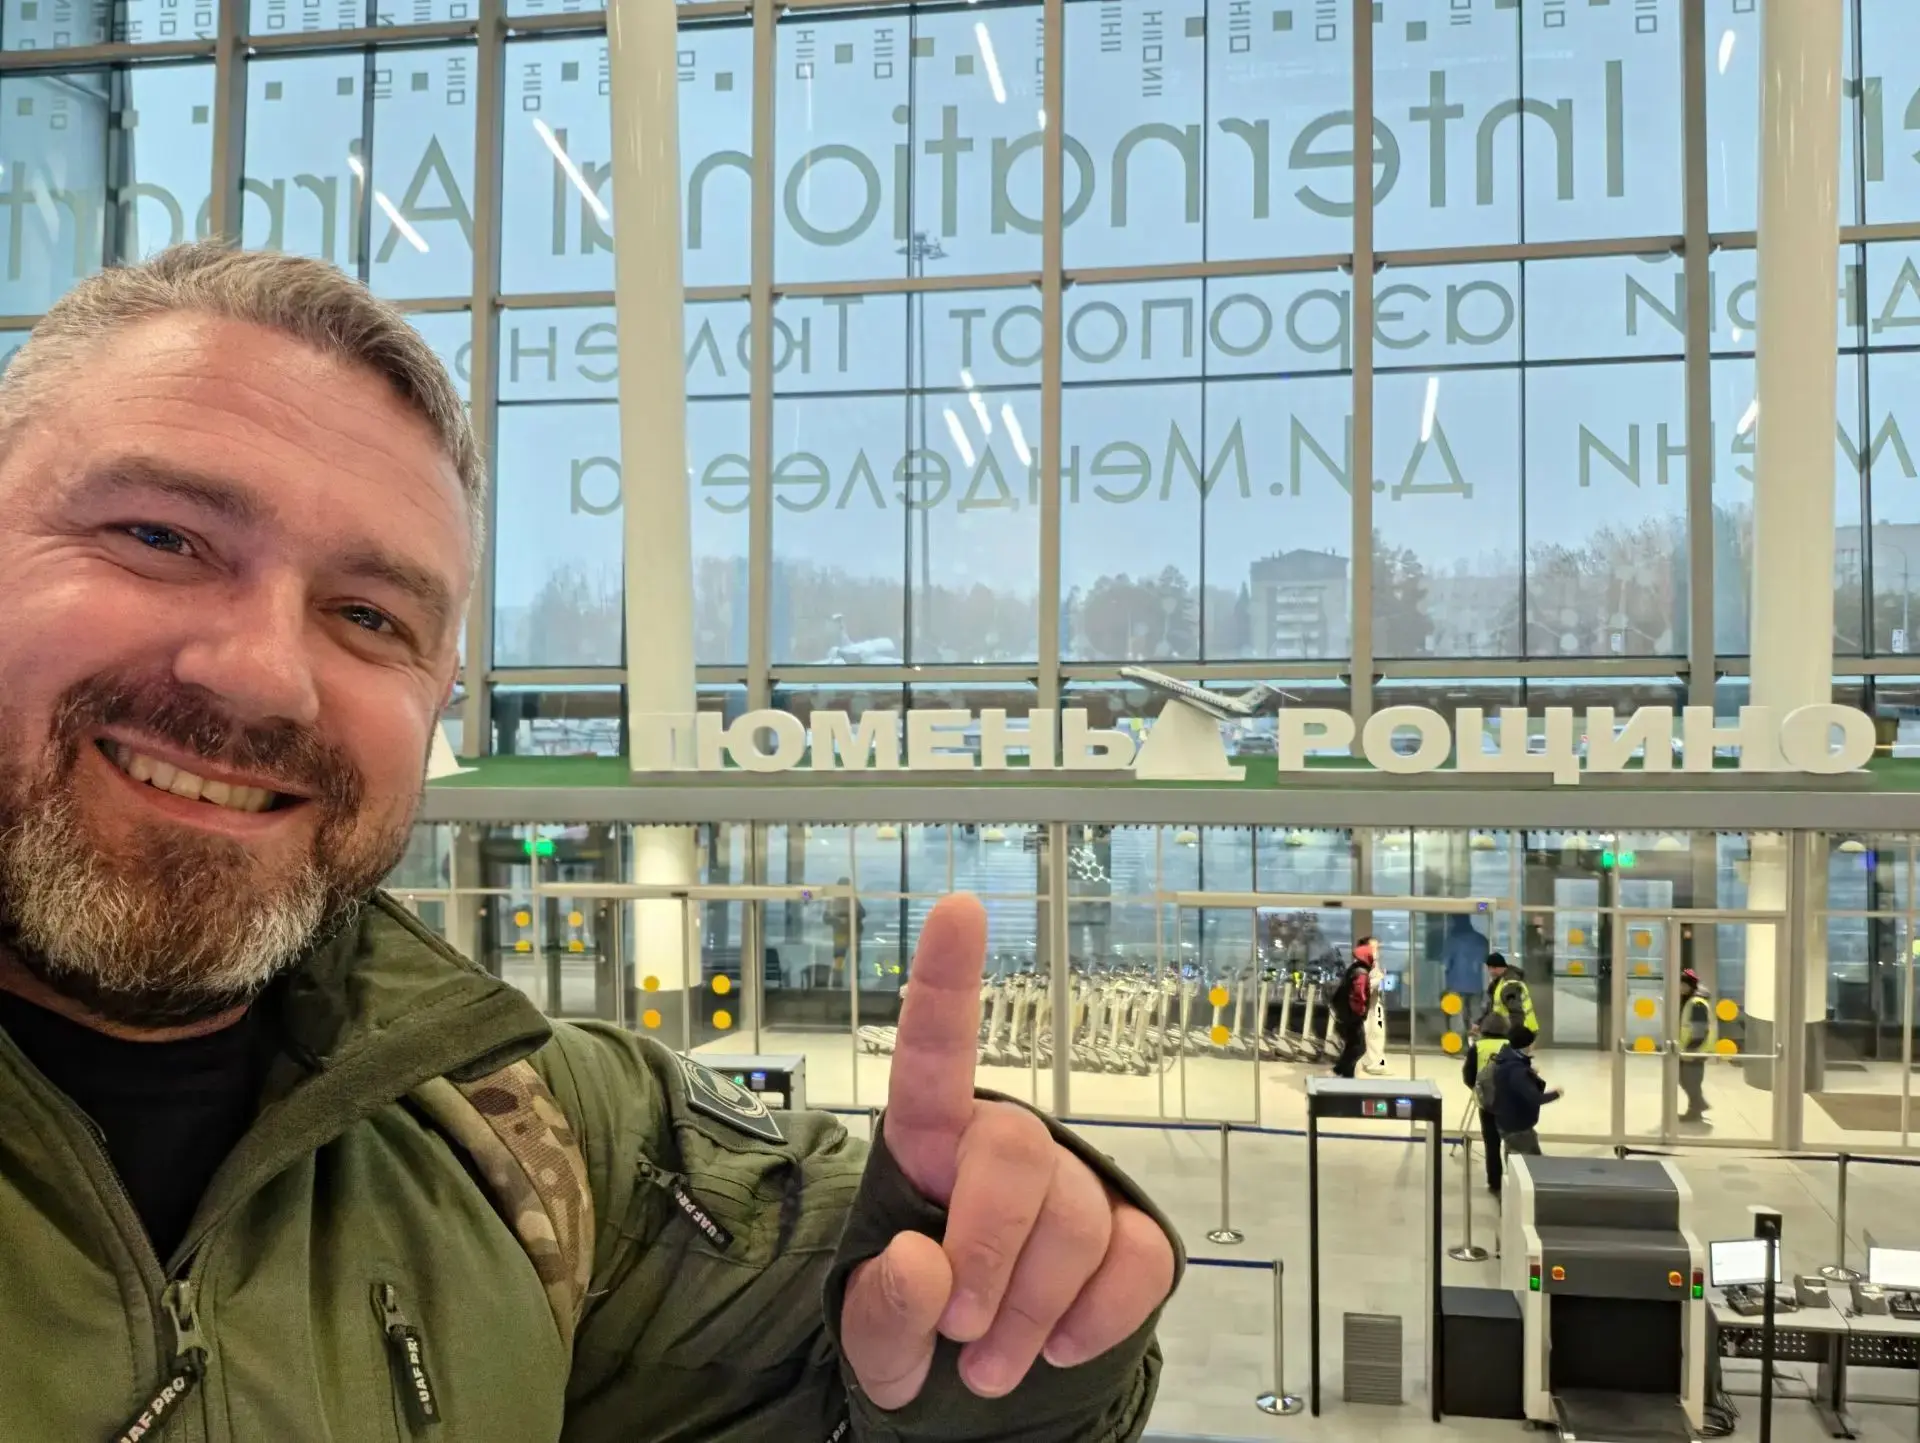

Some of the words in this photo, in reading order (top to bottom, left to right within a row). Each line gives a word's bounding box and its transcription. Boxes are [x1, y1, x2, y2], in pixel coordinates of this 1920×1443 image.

[630, 708, 1137, 772] ТЮМЕНЬ
[1278, 704, 1877, 785] РОЩИНО
[405, 1337, 420, 1364] PR
[151, 1376, 186, 1416] PRO
[412, 1366, 430, 1403] UAF
